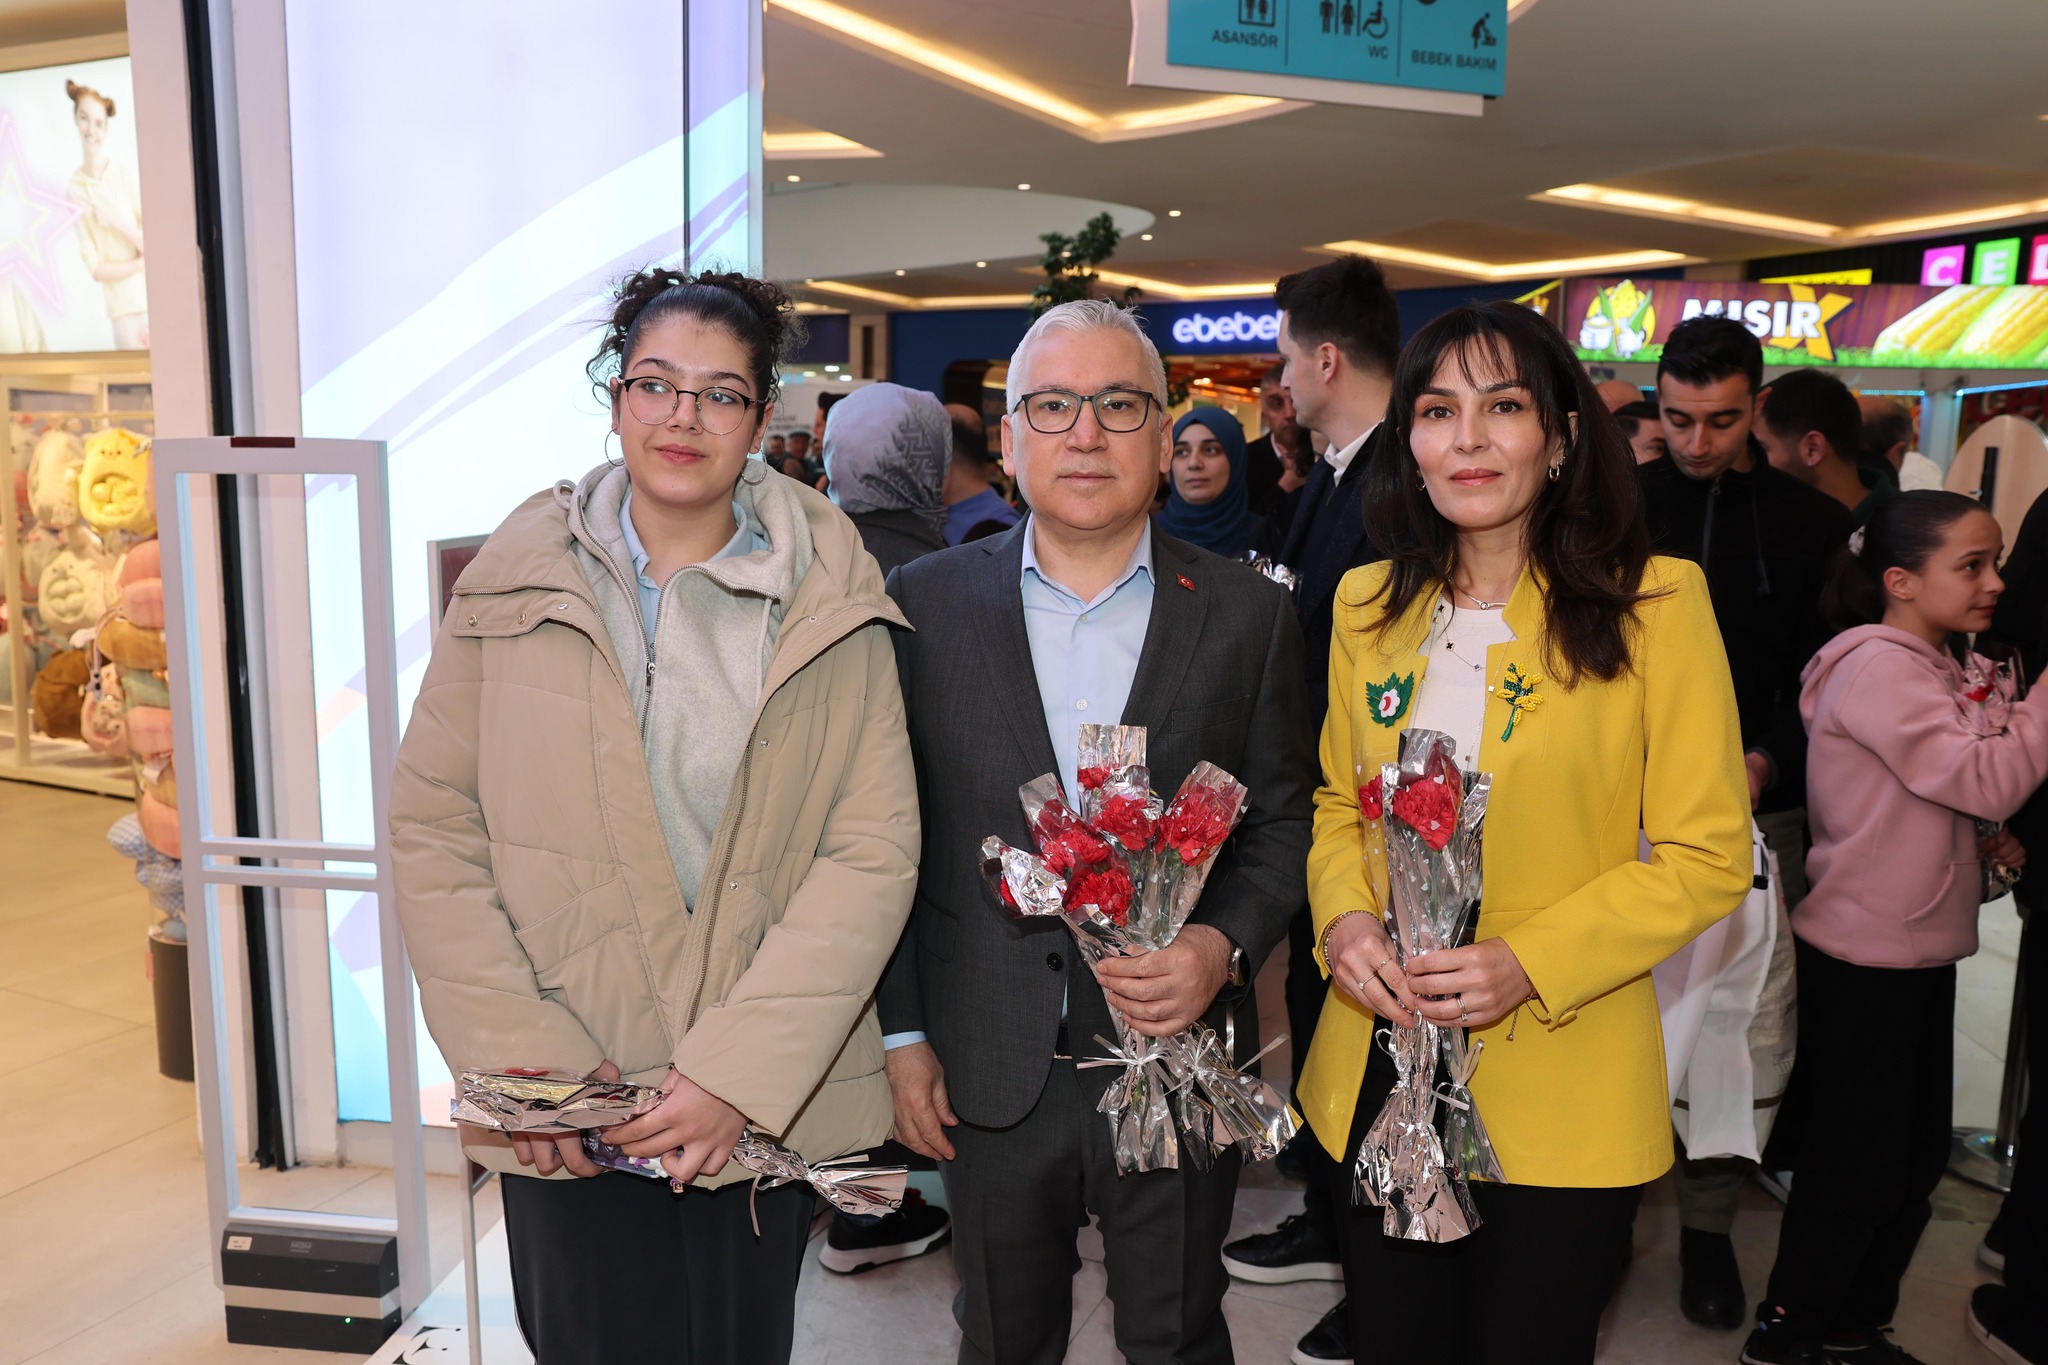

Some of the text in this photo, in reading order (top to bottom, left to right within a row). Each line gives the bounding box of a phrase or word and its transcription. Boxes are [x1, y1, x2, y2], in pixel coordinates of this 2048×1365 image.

[1211, 29, 1278, 48] ASANSÖR
[1368, 45, 1389, 59] WC
[1411, 50, 1496, 71] BEBEK BAKIM
